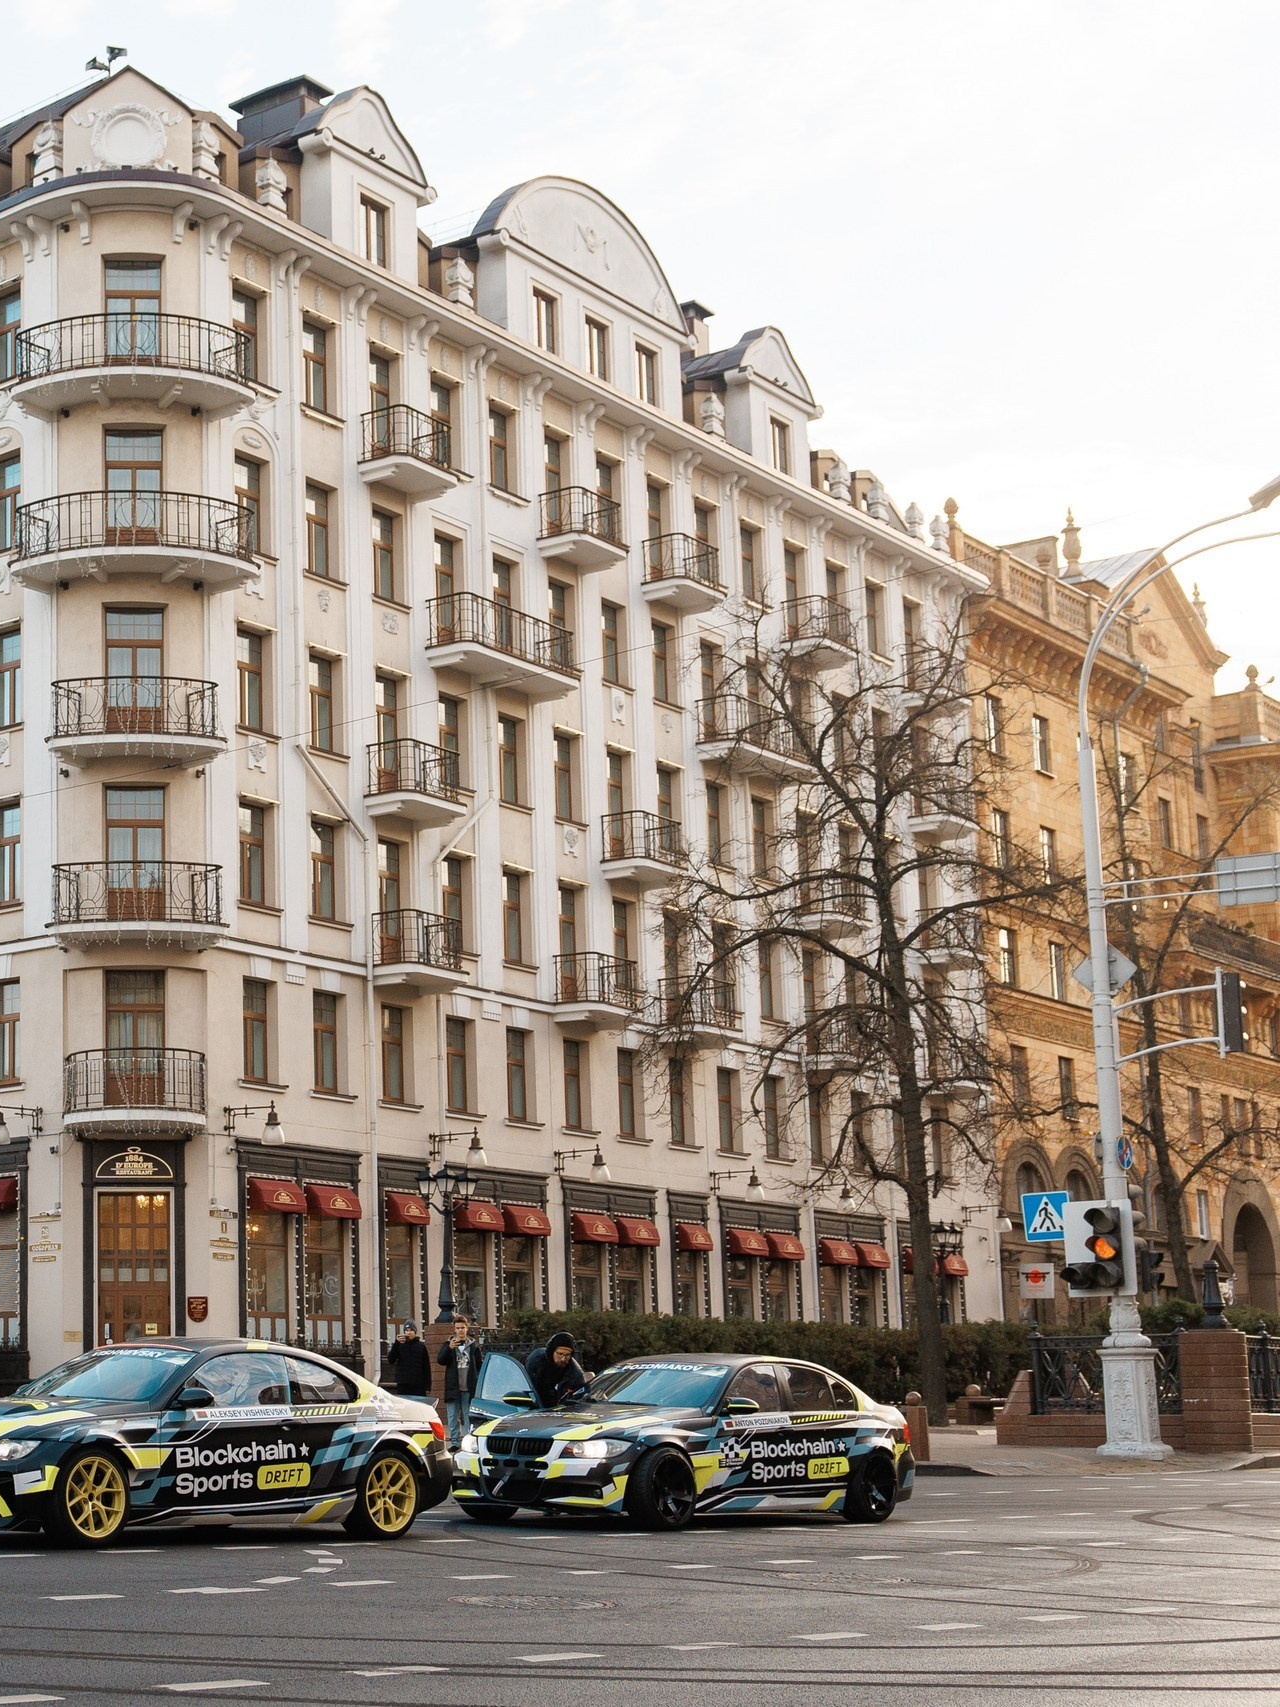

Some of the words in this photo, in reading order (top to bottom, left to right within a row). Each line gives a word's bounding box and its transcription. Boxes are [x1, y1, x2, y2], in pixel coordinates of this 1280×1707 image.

[125, 1154, 144, 1164] 1884
[92, 1349, 166, 1358] VISHNEVSKY
[622, 1363, 703, 1372] POZDNIAKOV
[209, 1408, 241, 1418] ALEKSEY
[243, 1407, 289, 1417] VISHNEVSKY
[734, 1418, 754, 1427] ANTON
[755, 1416, 789, 1426] POZDNIAKOV
[175, 1439, 297, 1469] Blockchain
[751, 1438, 836, 1459] Blockchain
[751, 1460, 806, 1483] Sports
[813, 1461, 842, 1475] DRIFT
[175, 1469, 254, 1498] Sports
[265, 1469, 304, 1484] DRIFT
